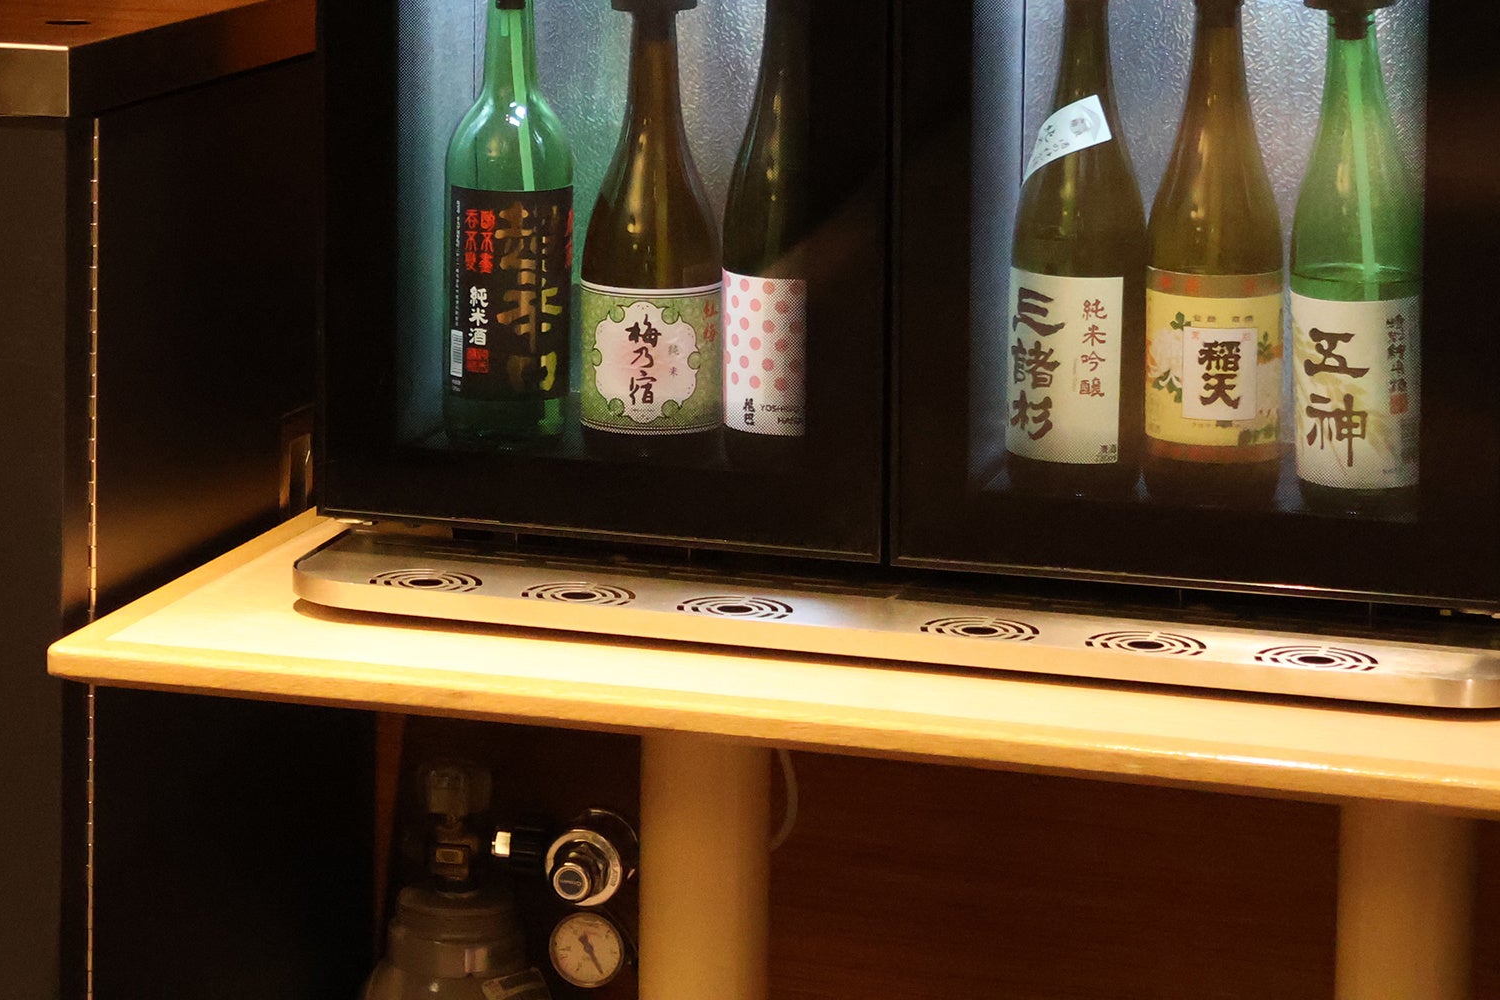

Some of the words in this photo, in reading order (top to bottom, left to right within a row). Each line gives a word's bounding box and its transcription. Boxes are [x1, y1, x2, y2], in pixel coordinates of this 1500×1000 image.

[468, 285, 489, 346] 純米酒
[625, 313, 662, 405] 梅乃宿
[1010, 287, 1066, 441] 三諸杉
[1304, 327, 1370, 467] 五神
